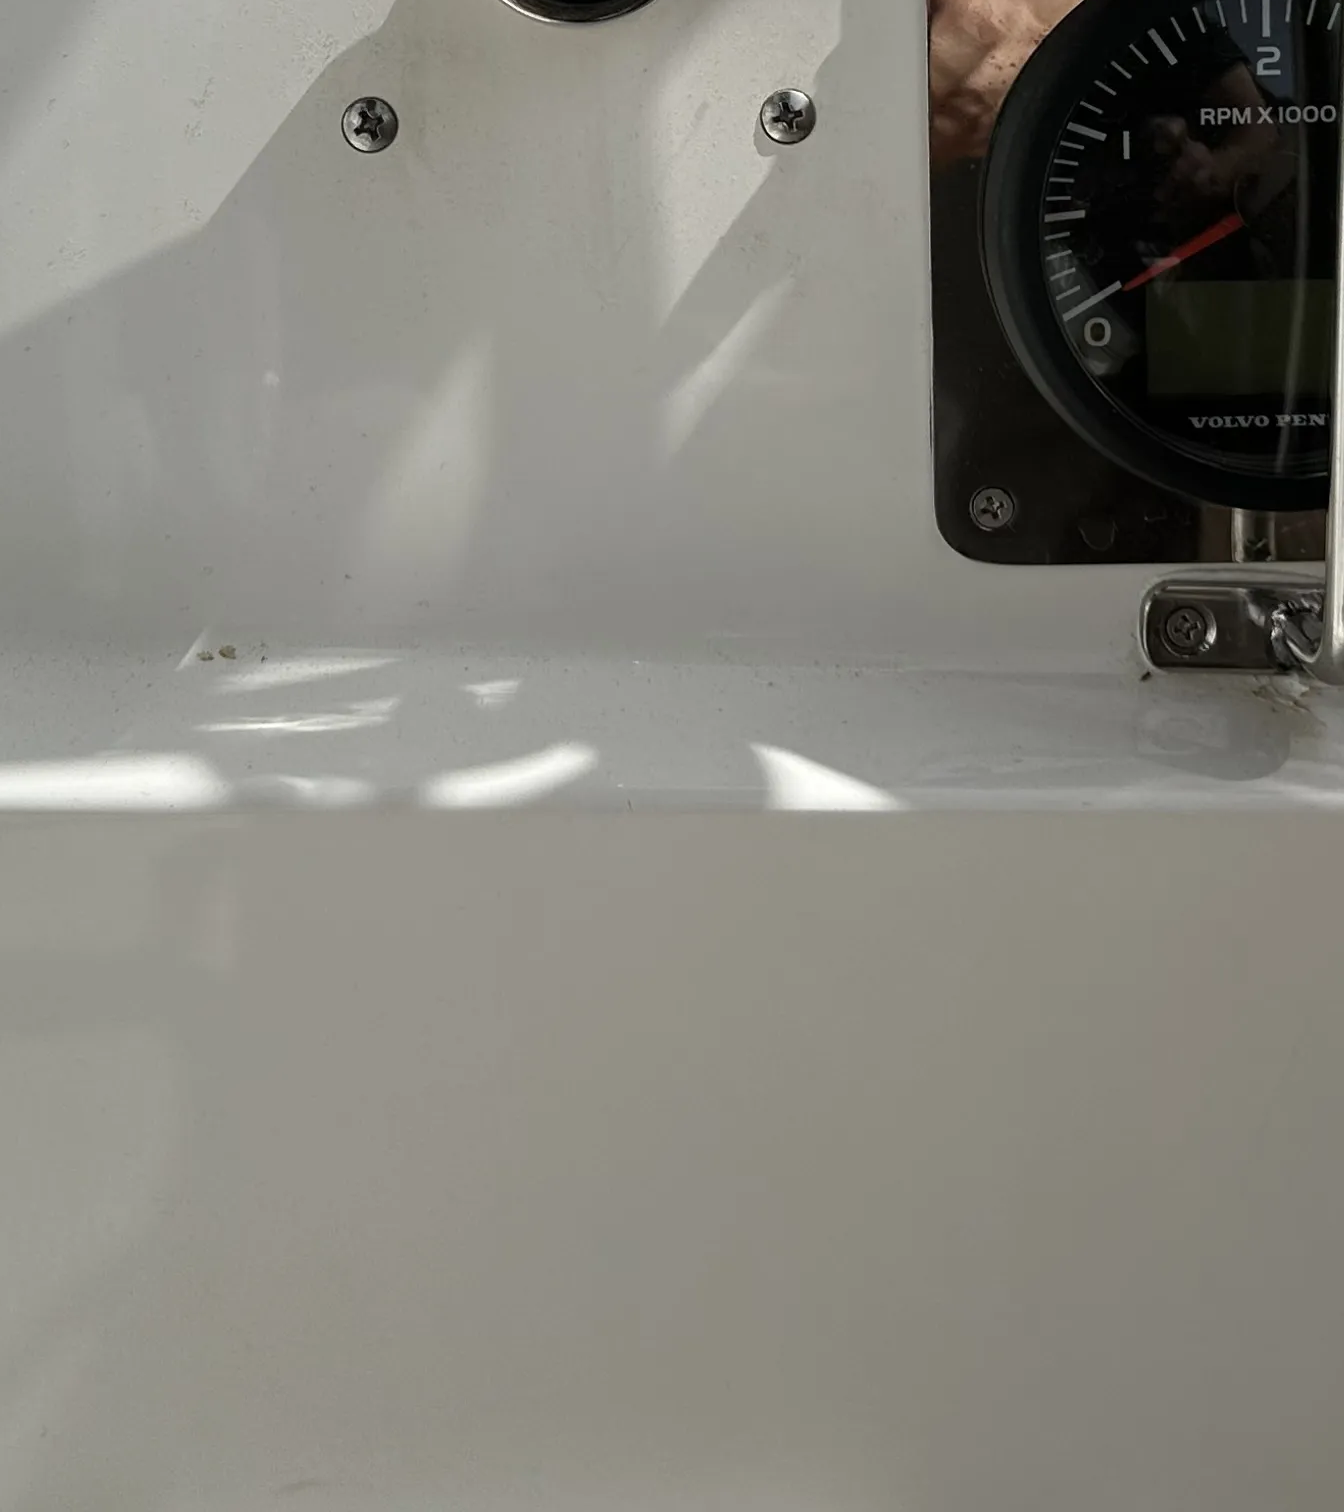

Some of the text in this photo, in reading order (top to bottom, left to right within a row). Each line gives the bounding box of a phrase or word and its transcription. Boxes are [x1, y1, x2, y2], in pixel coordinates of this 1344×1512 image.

[1256, 45, 1282, 76] 2
[1199, 105, 1338, 126] RPM X 1000
[1122, 131, 1131, 160] 1
[1086, 317, 1111, 347] 0
[1188, 413, 1331, 429] VOLVO PEN
